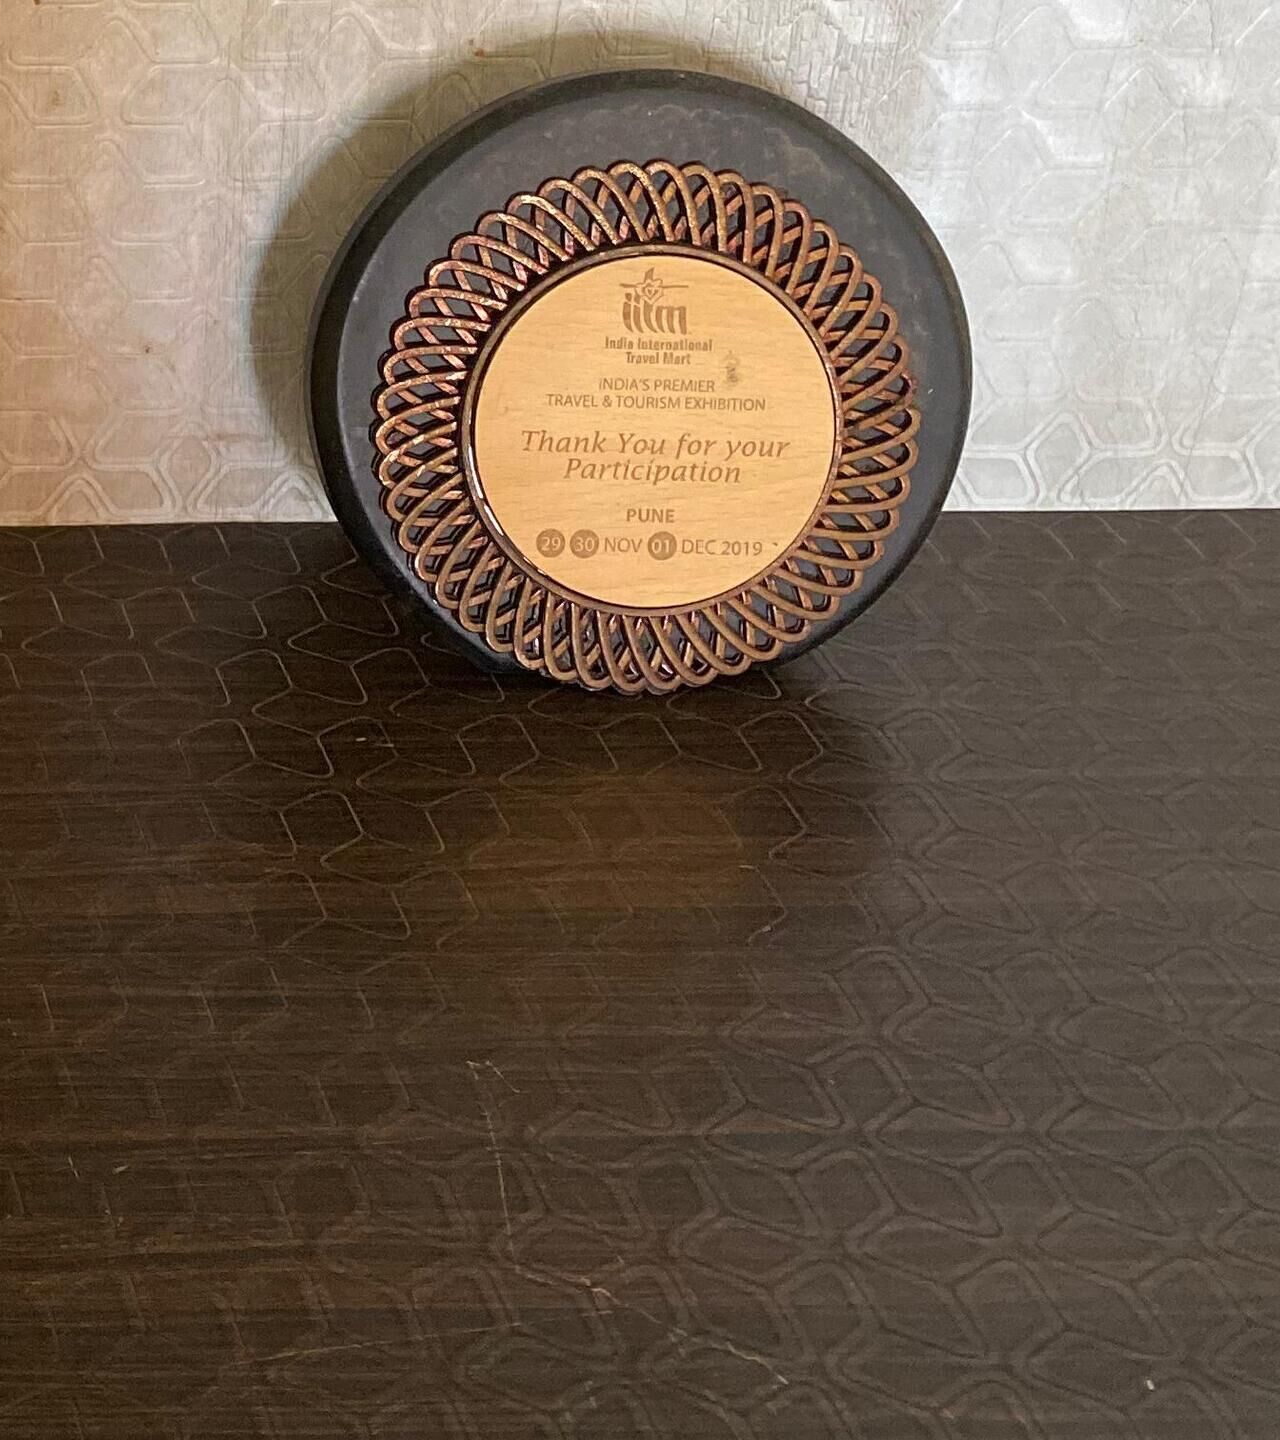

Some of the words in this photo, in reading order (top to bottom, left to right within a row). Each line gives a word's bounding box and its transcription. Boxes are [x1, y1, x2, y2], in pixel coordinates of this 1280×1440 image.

[605, 336, 633, 350] India
[637, 338, 712, 351] International
[626, 352, 660, 364] Travel
[663, 352, 691, 365] Mart
[599, 378, 650, 392] INDIA'S
[654, 379, 715, 392] PREMIER
[547, 394, 598, 408] TRAVEL
[602, 395, 613, 408] &
[616, 395, 682, 410] TOURISM
[685, 396, 766, 411] EXHIBITION
[522, 430, 607, 454] Thank
[618, 433, 666, 455] You
[676, 432, 718, 459] for
[725, 440, 791, 464] your
[563, 458, 741, 486] Participation
[626, 508, 675, 524] PUNE
[540, 536, 561, 552] 29
[574, 537, 595, 552] 30
[604, 537, 643, 553] NOV
[651, 539, 673, 554] 01
[681, 539, 717, 555] DEC
[720, 541, 763, 557] 2019
